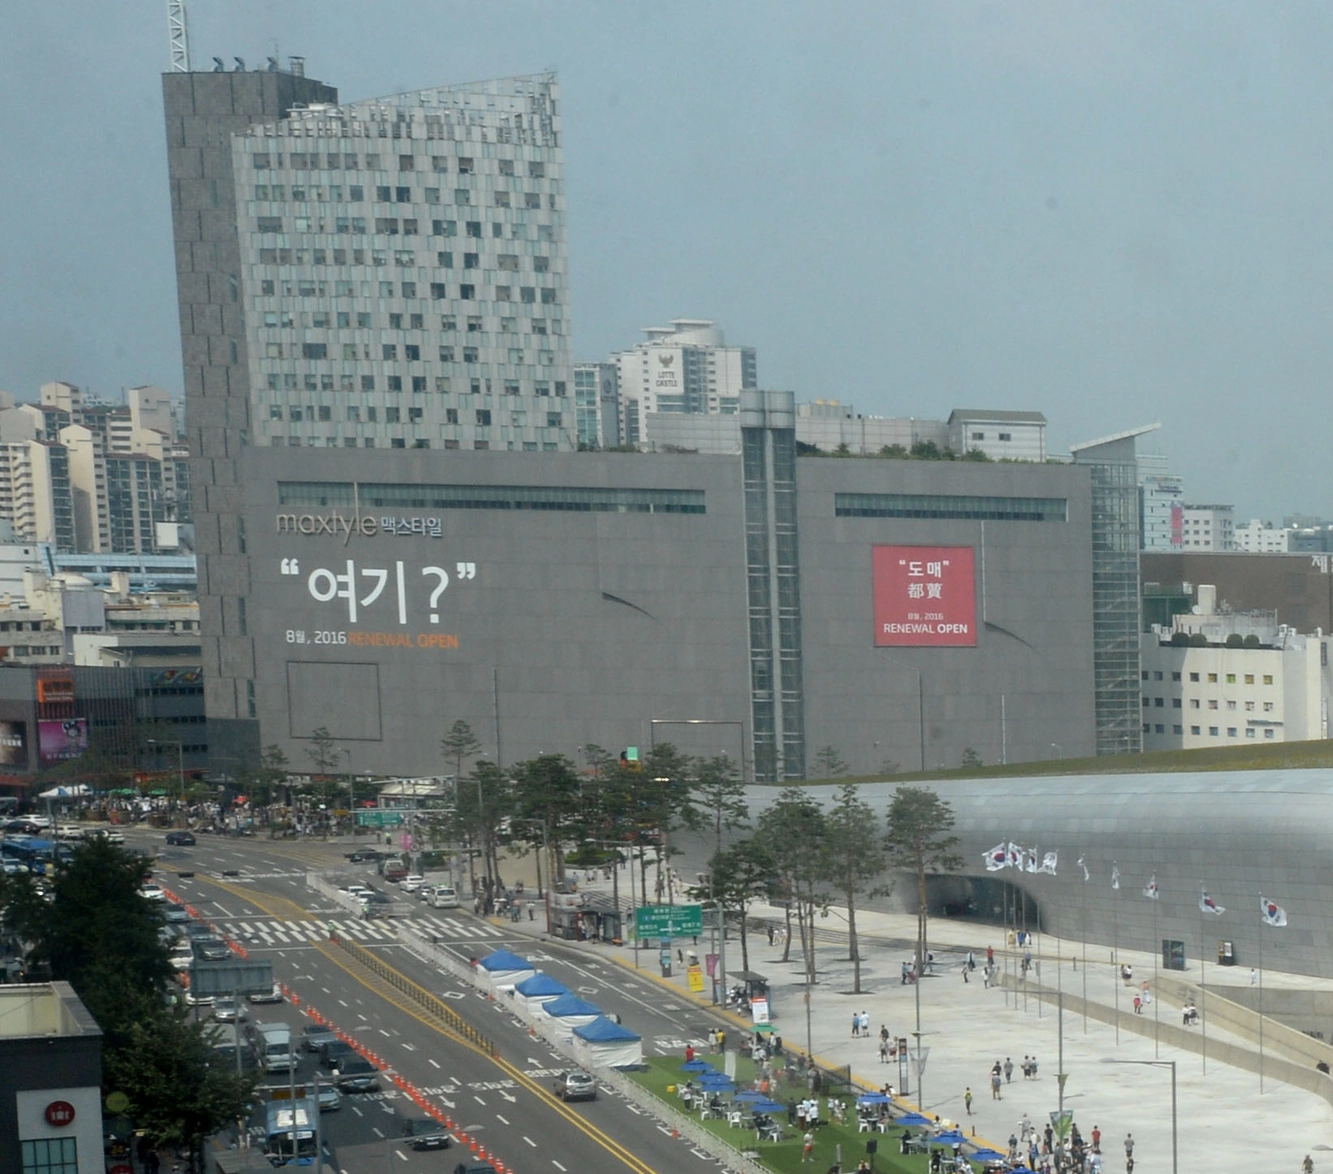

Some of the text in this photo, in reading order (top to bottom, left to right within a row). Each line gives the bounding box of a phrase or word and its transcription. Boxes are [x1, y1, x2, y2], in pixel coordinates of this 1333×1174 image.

[381, 516, 442, 537] 맥스타일
[883, 623, 968, 634] RENEWAL OPEN
[314, 631, 347, 645] 2016
[348, 632, 412, 648] RENEWAL
[417, 633, 459, 648] OPEN
